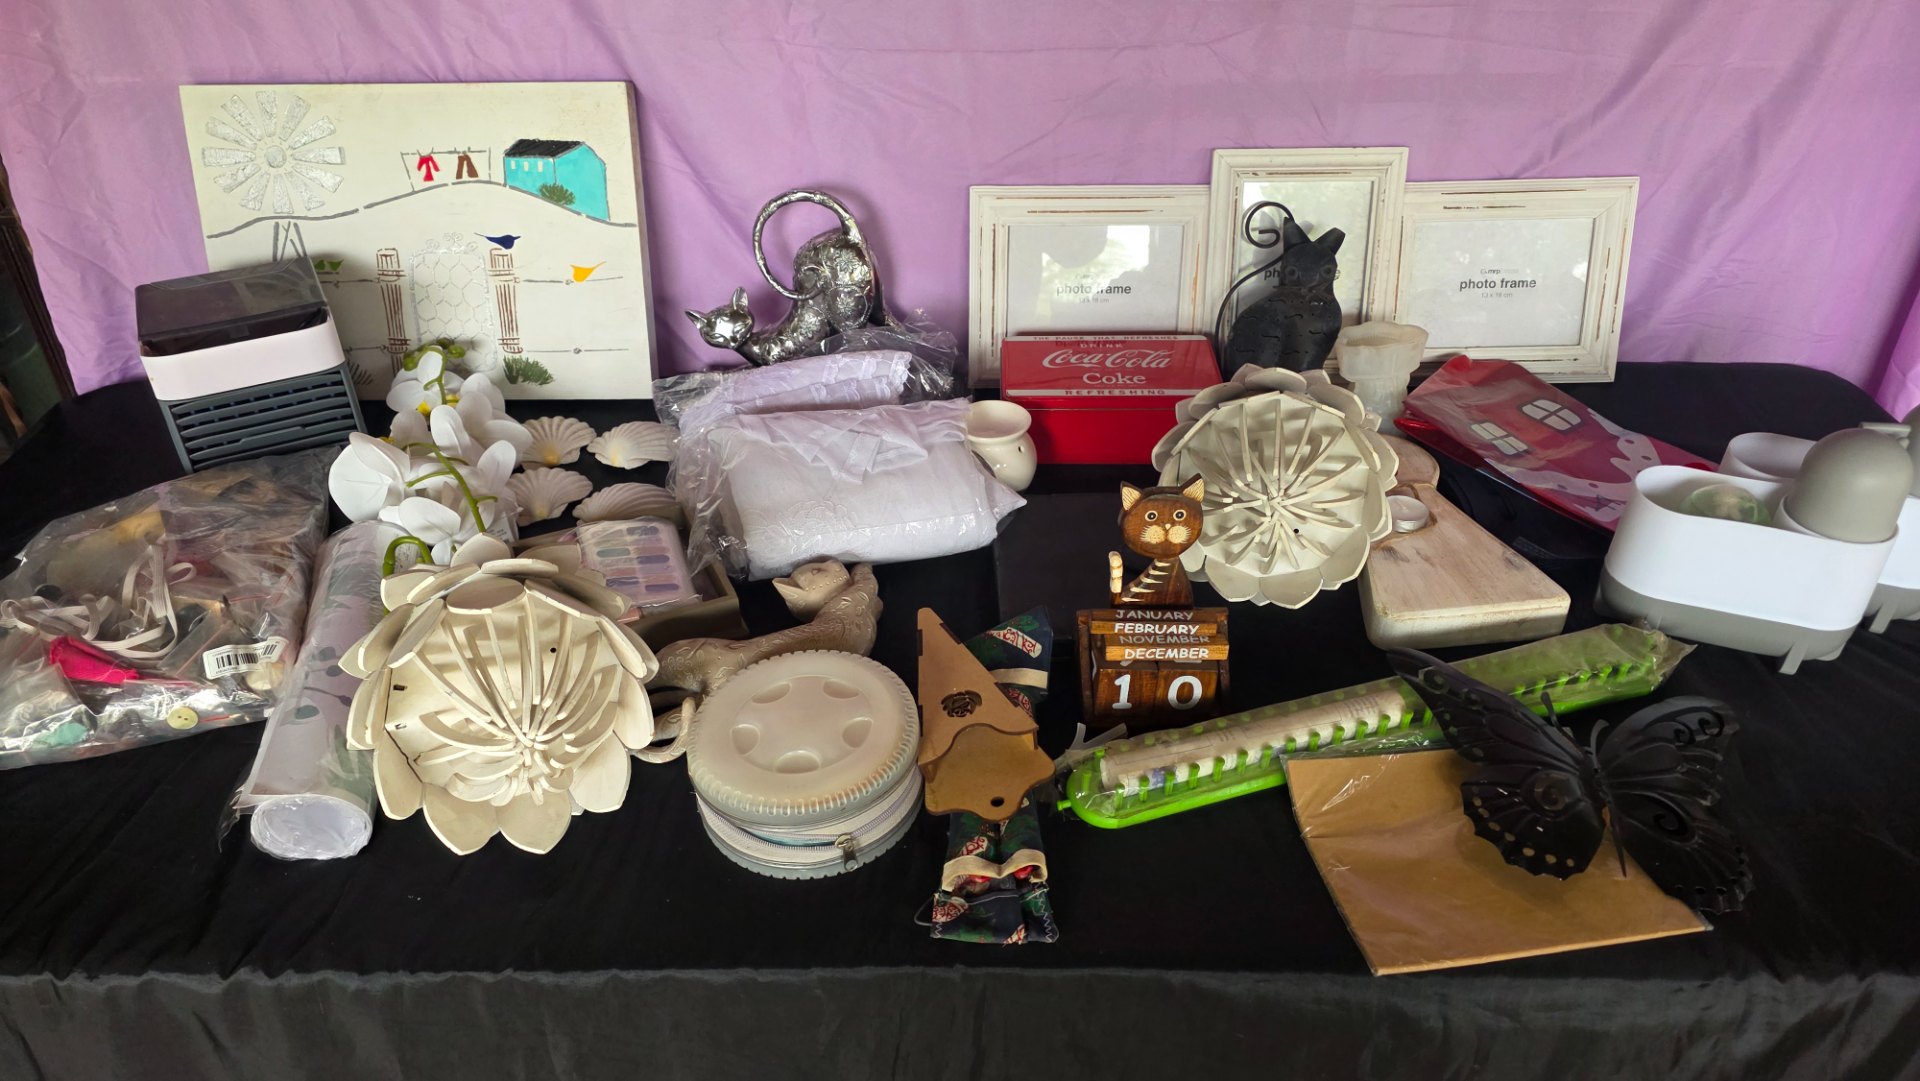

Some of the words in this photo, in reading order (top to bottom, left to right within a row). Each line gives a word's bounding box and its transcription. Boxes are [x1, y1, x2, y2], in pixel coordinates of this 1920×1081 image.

[1056, 284, 1092, 296] photo
[1096, 285, 1132, 294] ame
[1459, 279, 1496, 292] photo
[1500, 277, 1537, 288] frame
[1082, 372, 1147, 385] Coke
[1115, 610, 1194, 620] JANUARY
[1114, 622, 1200, 635] FEBRUARY
[1119, 635, 1211, 644] NOVEMBER
[1124, 648, 1210, 660] DECEMBER
